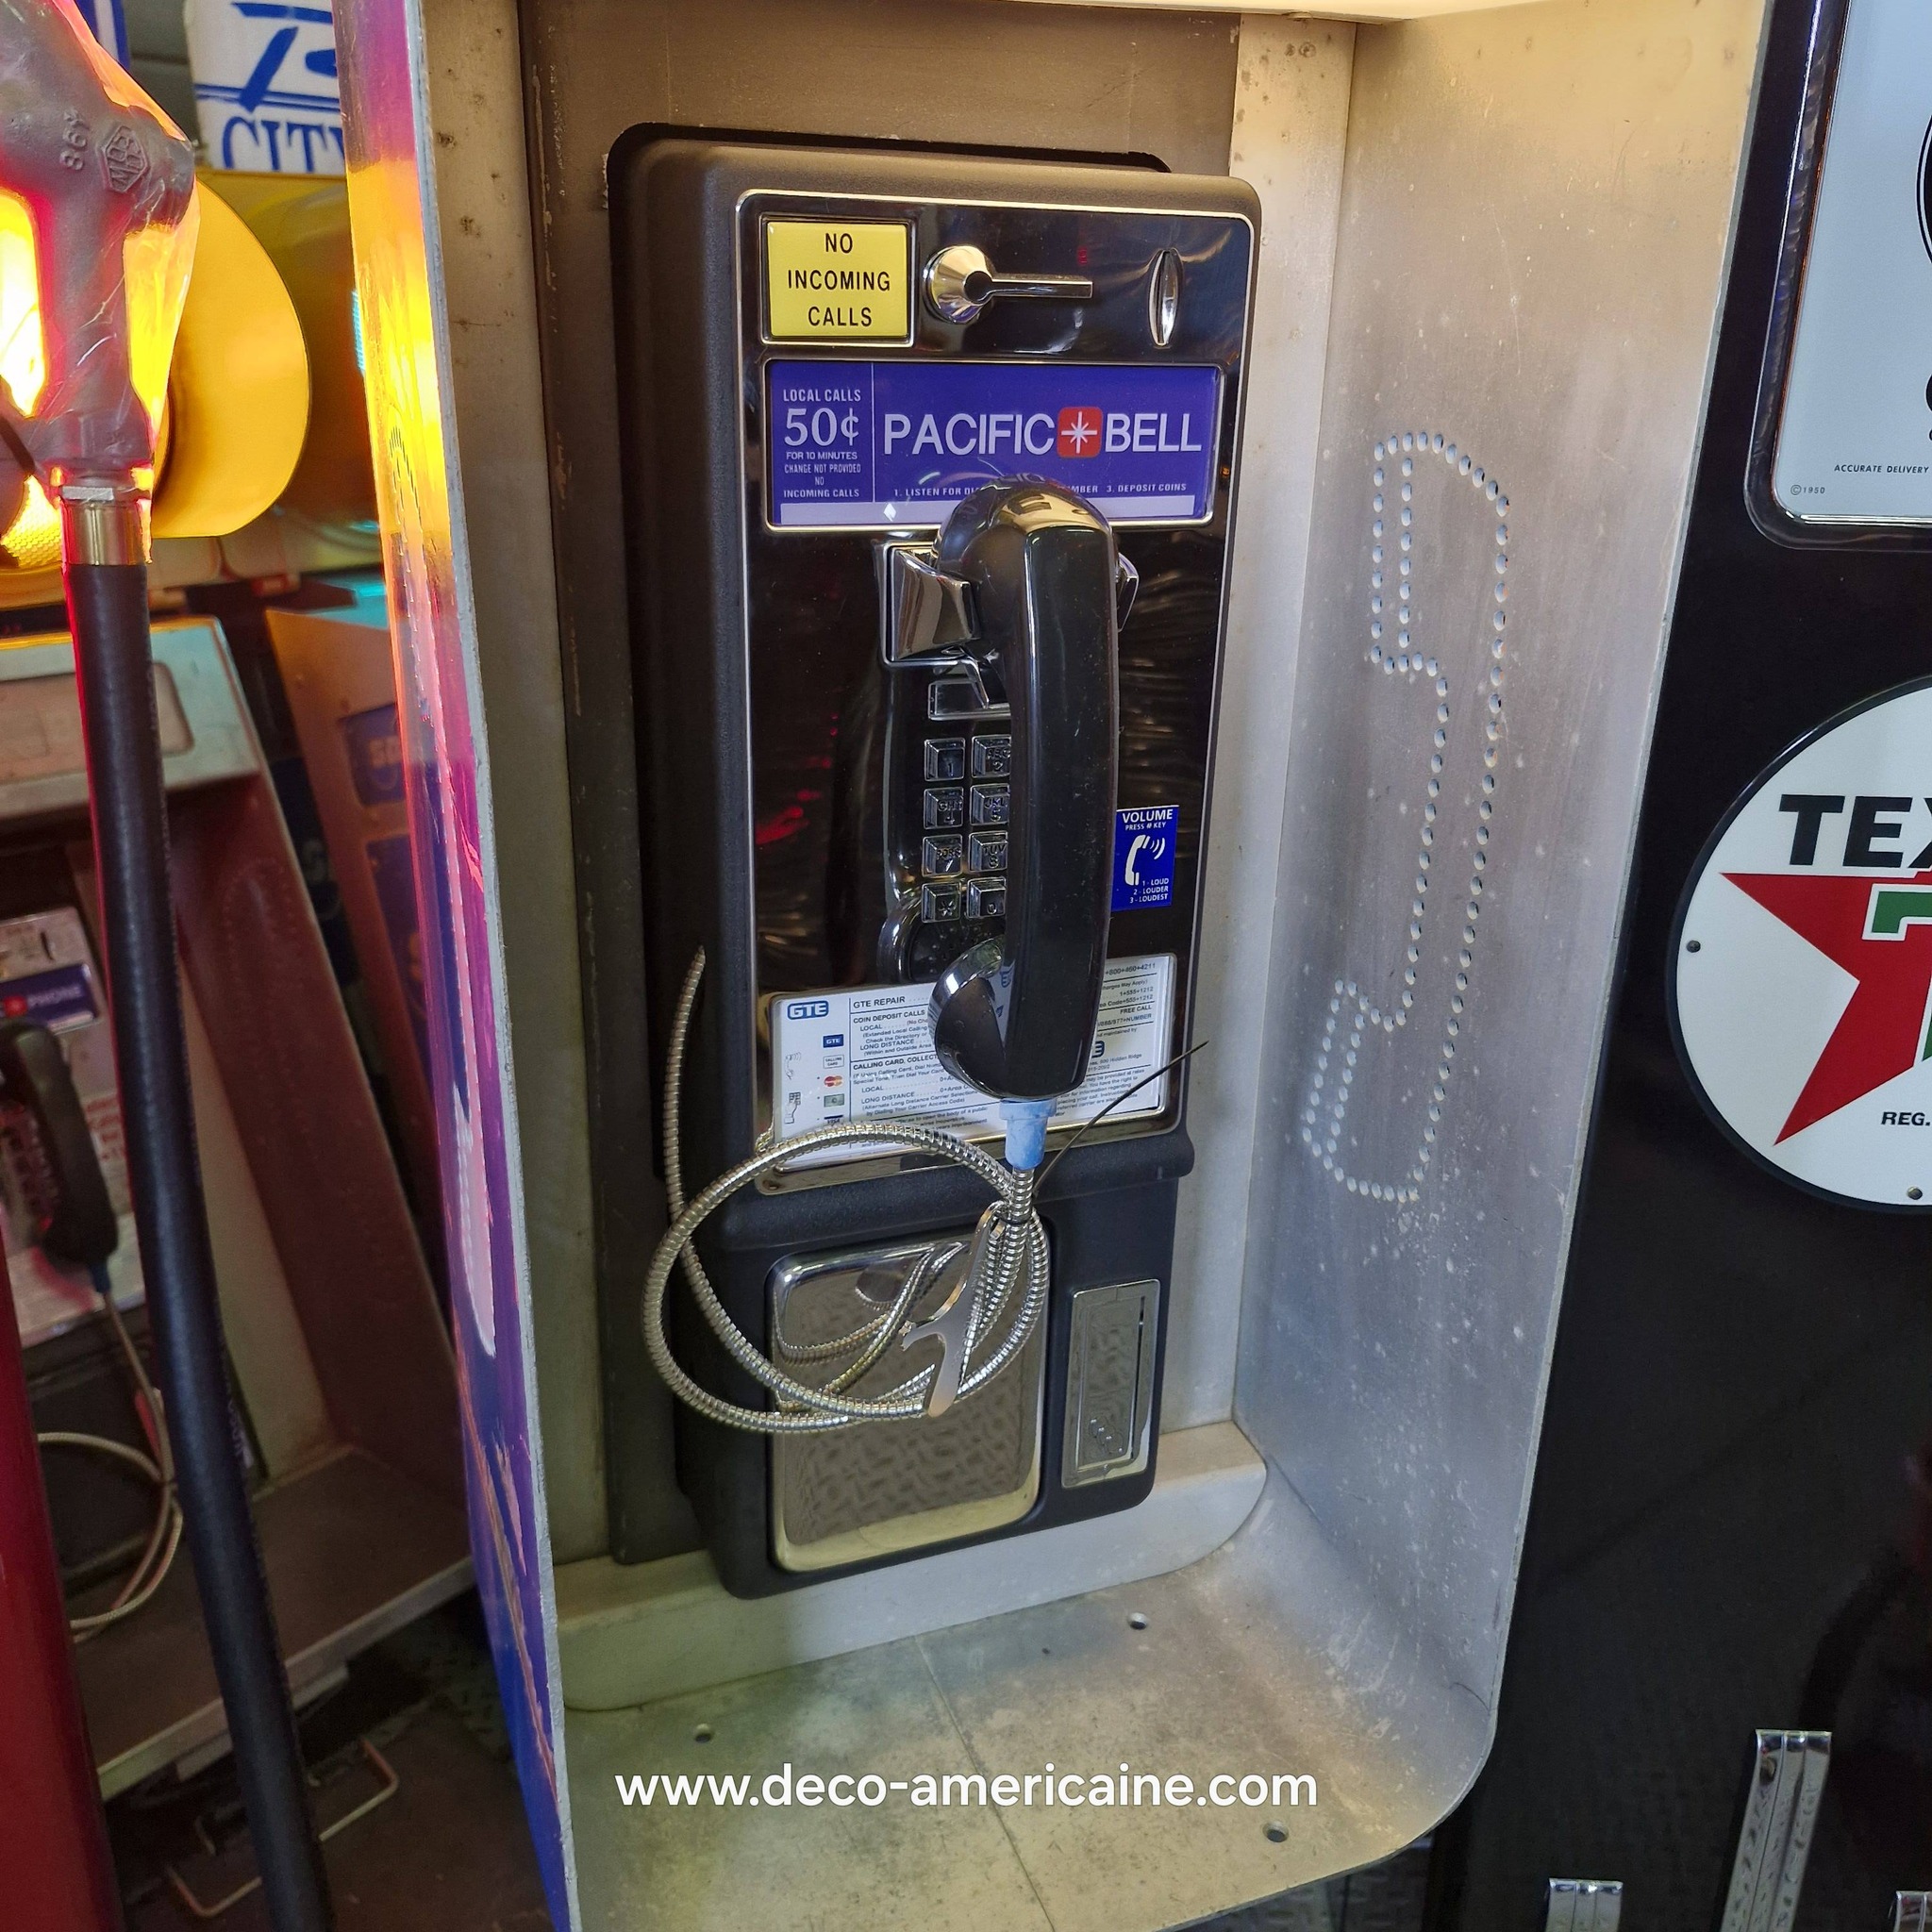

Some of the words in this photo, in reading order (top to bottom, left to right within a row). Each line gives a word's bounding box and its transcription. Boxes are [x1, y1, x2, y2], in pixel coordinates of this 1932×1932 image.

[824, 233, 854, 254] NO
[787, 270, 891, 292] INCOMING
[808, 307, 873, 327] CALLS
[783, 390, 821, 402] LOCAL
[824, 389, 861, 402] CALLS
[784, 408, 859, 446] 50¢
[884, 412, 1055, 456] PACIFIC
[1105, 412, 1202, 453] BELL
[786, 452, 804, 460] FOR
[807, 452, 816, 460] 10
[817, 451, 858, 460] MINUTES
[784, 463, 811, 474] CHANGE
[814, 463, 827, 474] NOT
[829, 463, 861, 474] PROVIDED
[1834, 464, 1882, 473] ACCURATE
[1887, 465, 1929, 474] DELIVERY
[814, 476, 824, 486] NO
[783, 489, 830, 498] INCOMING
[832, 489, 860, 498] CALLS
[906, 488, 940, 496] LISTEN
[942, 487, 961, 496] FOR
[1068, 485, 1098, 493] MBER
[1117, 484, 1156, 493] DEPOSIT
[1158, 483, 1187, 491] COINS
[1122, 808, 1174, 824] VOLUME
[1151, 877, 1170, 886] LOUD
[1142, 885, 1169, 894] LOUDER
[1139, 893, 1168, 902] LOUDEST
[853, 1000, 872, 1008] GTE
[874, 996, 906, 1006] REPAIR
[788, 1000, 829, 1020] GTE
[873, 1012, 903, 1022] DEPOSIT
[859, 1042, 879, 1051] LONG
[880, 1039, 914, 1048] DISTANCE
[853, 1061, 883, 1070] CALLING
[860, 1096, 880, 1105] LONG
[881, 1091, 915, 1101] DISTANCE
[1881, 1110, 1931, 1126] REG.
